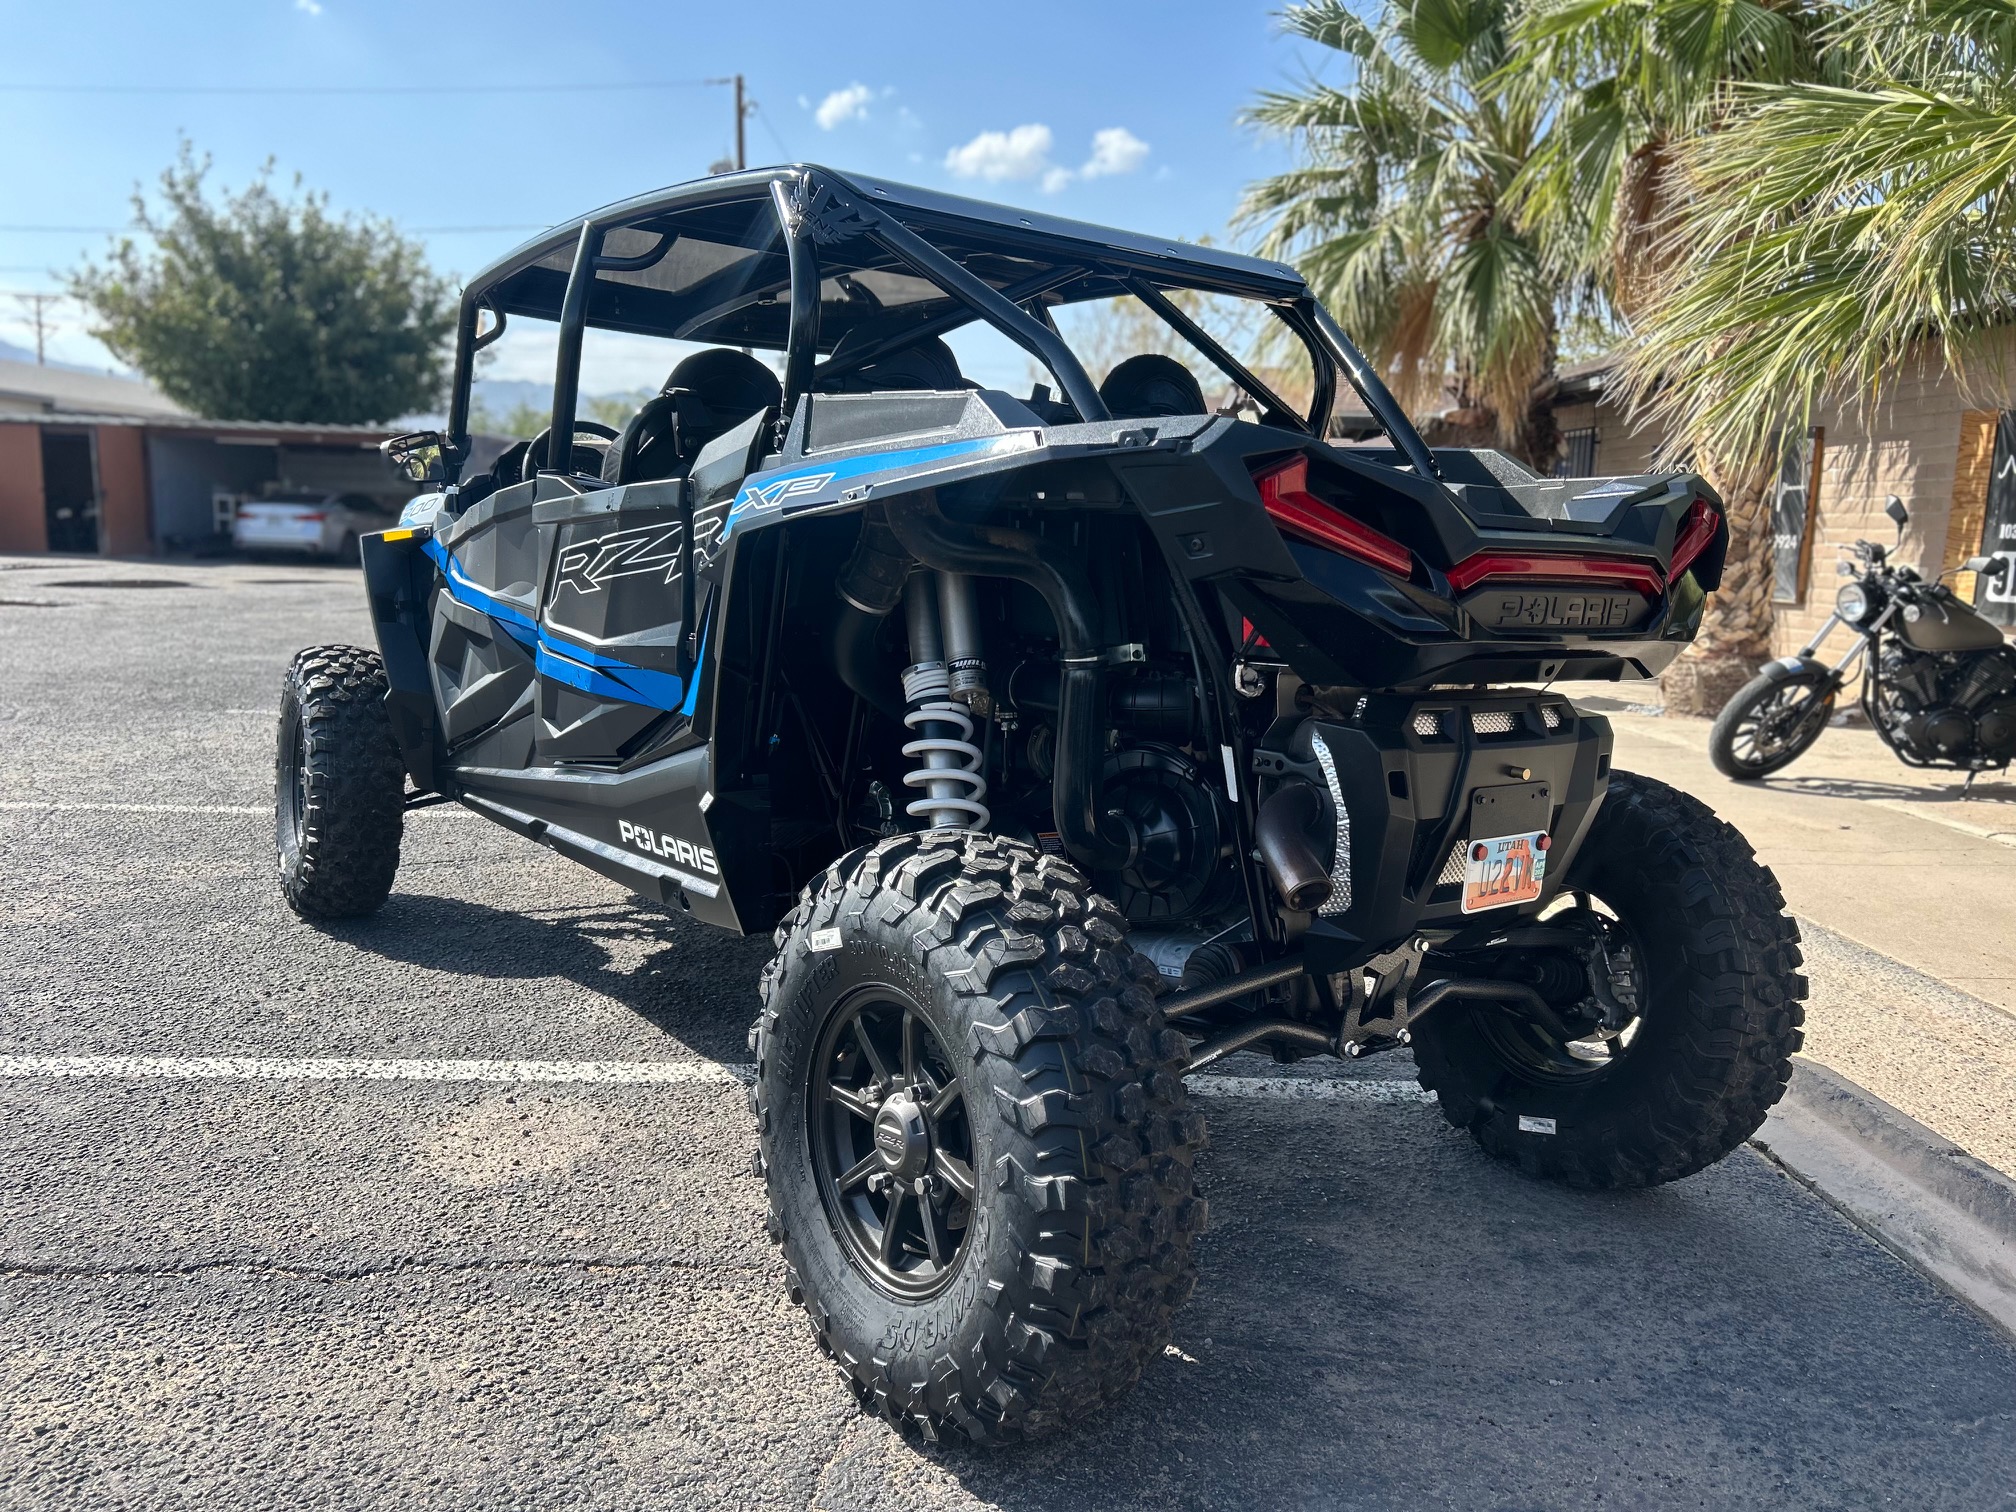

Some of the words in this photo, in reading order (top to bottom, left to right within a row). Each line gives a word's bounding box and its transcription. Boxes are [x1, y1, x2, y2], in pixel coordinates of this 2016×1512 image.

[730, 472, 836, 515] XP
[549, 499, 734, 610] RZR
[1497, 595, 1631, 625] POLARIS
[618, 819, 719, 875] POLARIS
[1497, 839, 1524, 853] UTAH
[876, 1132, 905, 1150] RZR
